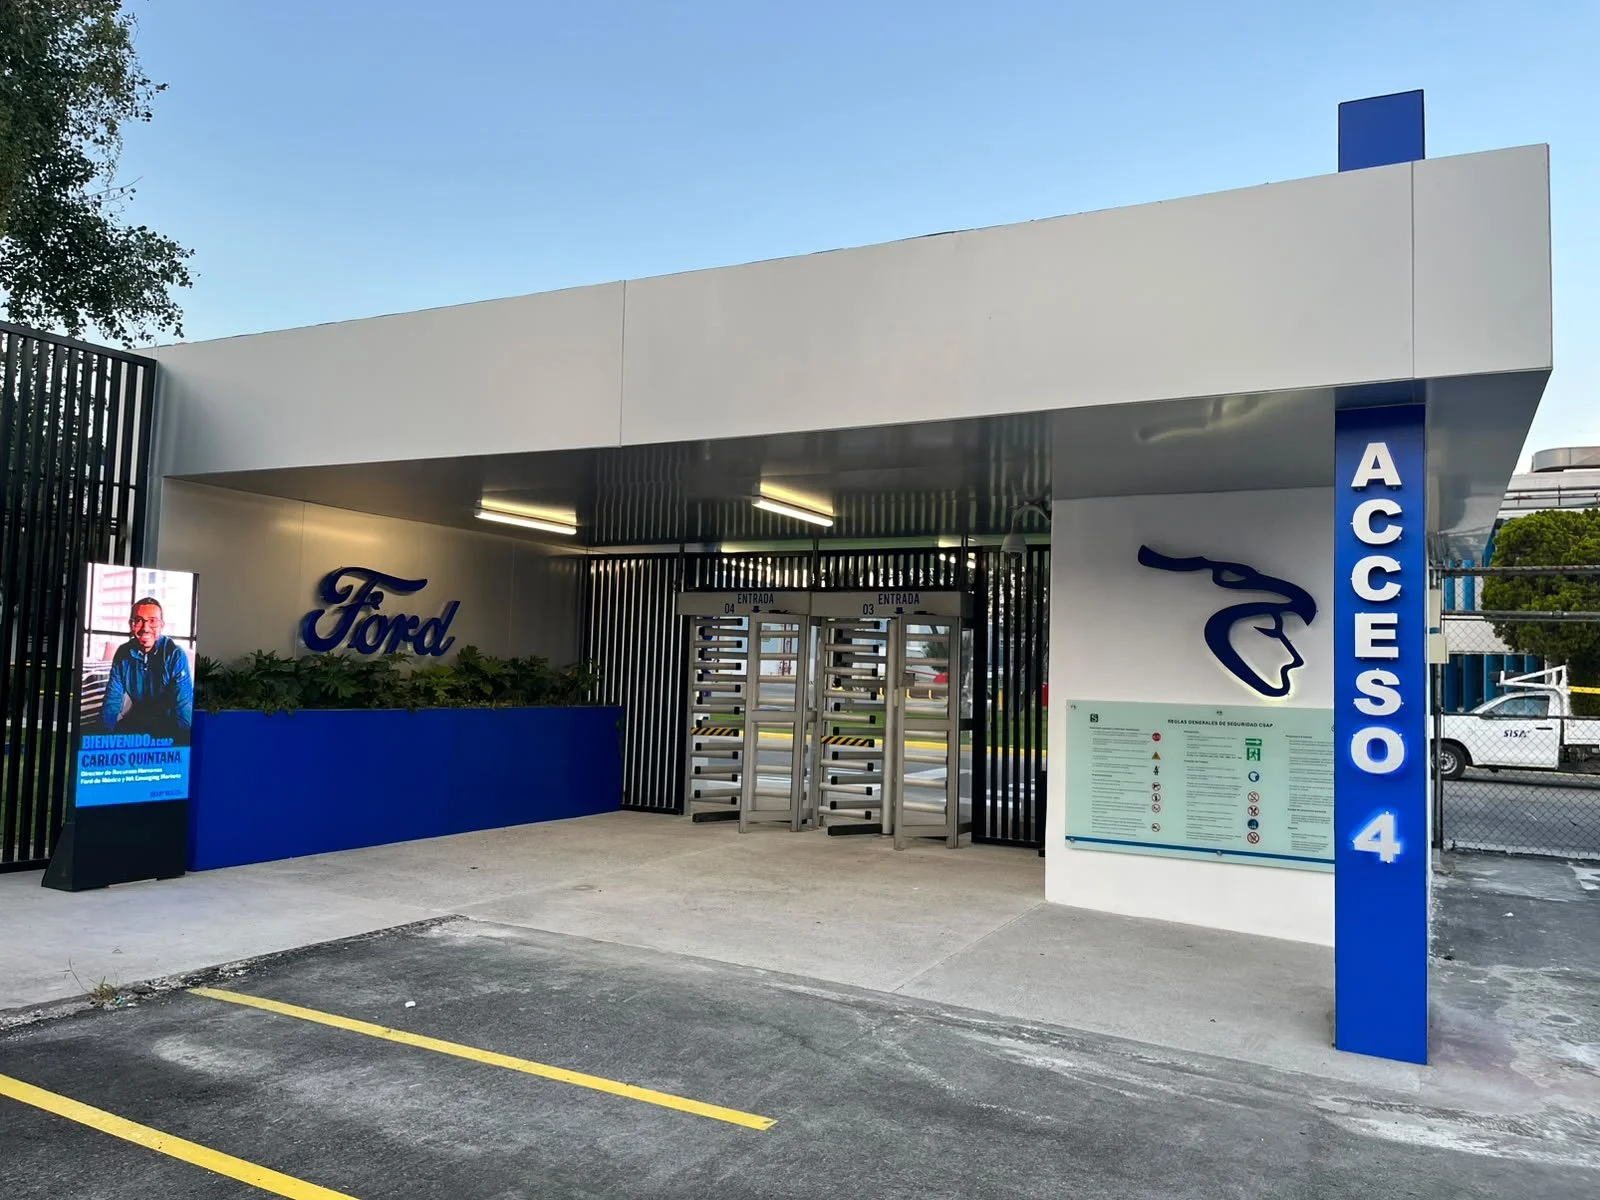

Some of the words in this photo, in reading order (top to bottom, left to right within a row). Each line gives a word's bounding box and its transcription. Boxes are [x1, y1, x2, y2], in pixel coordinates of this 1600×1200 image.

[737, 593, 775, 604] ENTRADA
[878, 593, 920, 605] ENTRADA
[302, 566, 461, 656] Ford
[724, 603, 735, 614] 04
[862, 603, 875, 615] 03
[1350, 442, 1405, 774] ACCESO
[82, 734, 150, 749] BIENVENIDO
[81, 753, 127, 767] CARLOS
[128, 751, 181, 768] QUINTANA
[1353, 812, 1401, 864] 4
